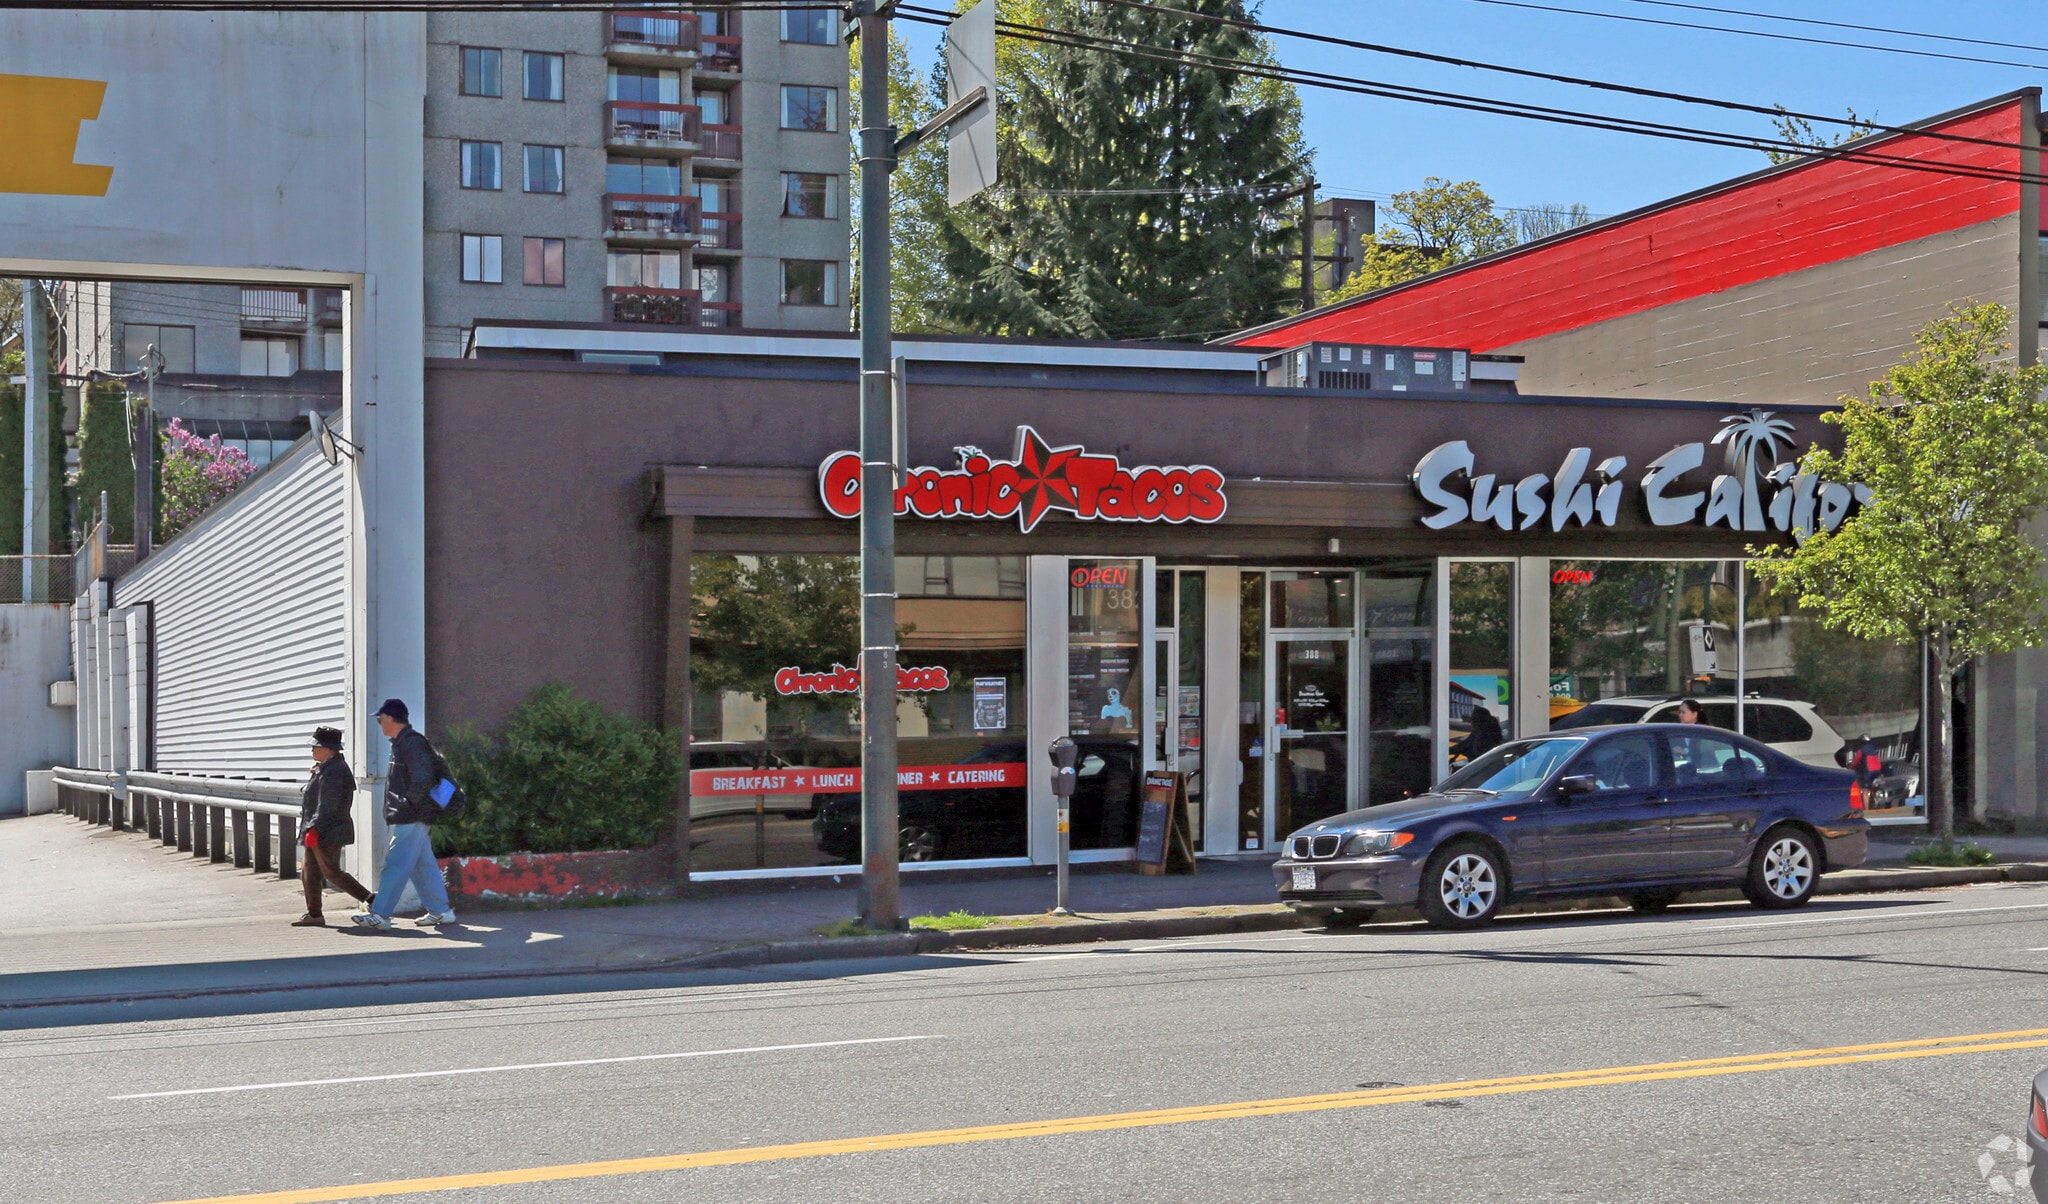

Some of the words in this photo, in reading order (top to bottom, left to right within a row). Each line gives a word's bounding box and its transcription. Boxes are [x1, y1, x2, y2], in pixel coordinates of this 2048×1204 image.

[819, 451, 1021, 519] Cronic
[1066, 454, 1227, 522] Tacos
[1413, 440, 1628, 533] Sushi
[1071, 567, 1128, 587] OPEN
[1552, 570, 1594, 583] OPEN
[1107, 589, 1138, 609] 38
[1305, 650, 1319, 659] 388
[774, 662, 861, 695] Chronic
[896, 663, 949, 691] acos
[713, 776, 786, 790] BREAKFAST
[812, 774, 853, 787] LUNCH
[948, 769, 1005, 784] CATERING
